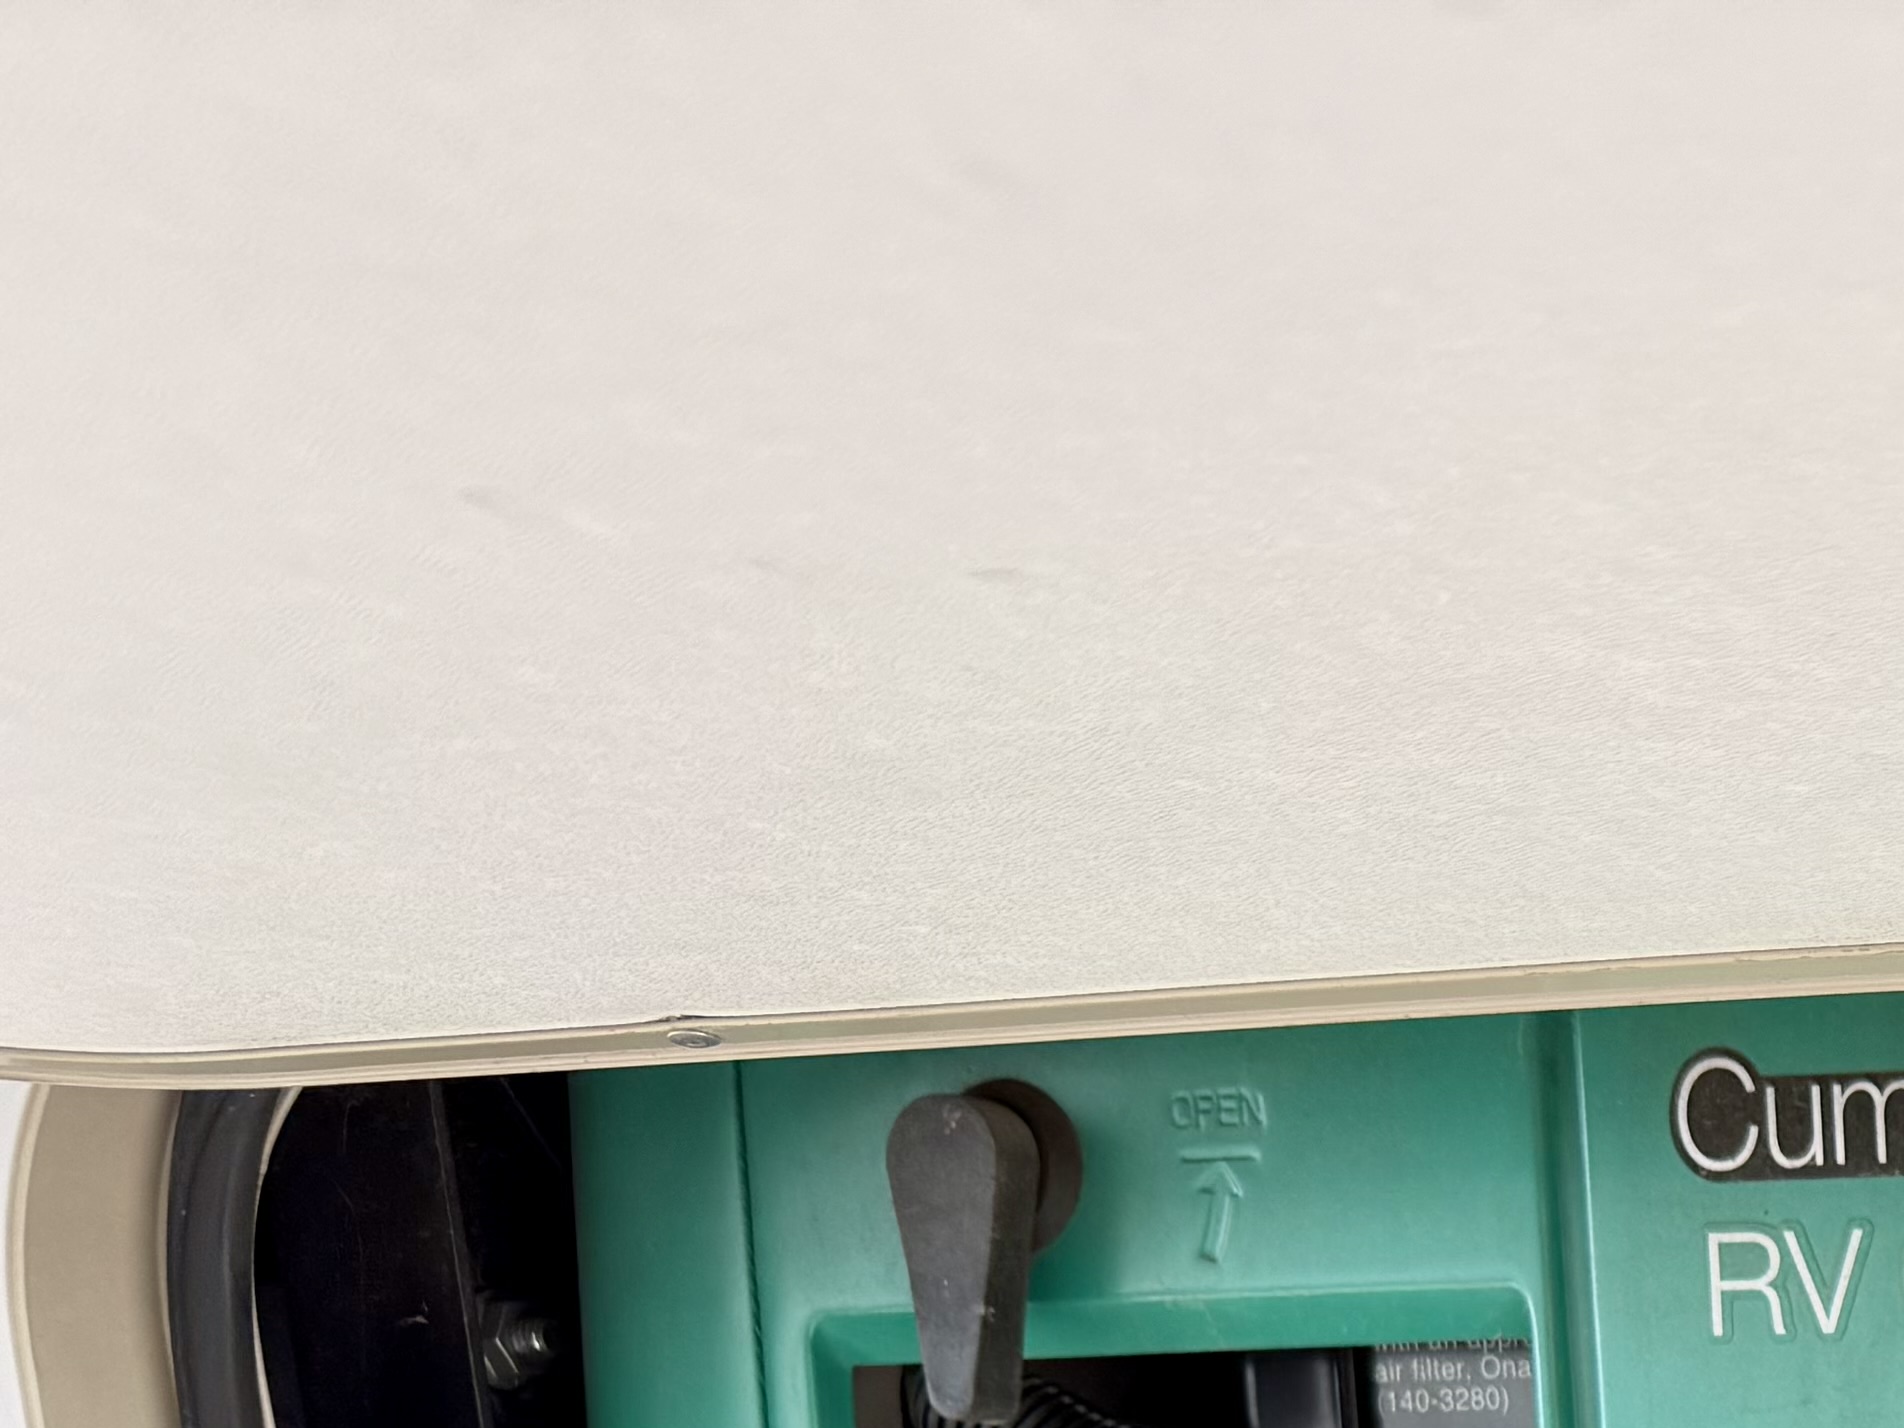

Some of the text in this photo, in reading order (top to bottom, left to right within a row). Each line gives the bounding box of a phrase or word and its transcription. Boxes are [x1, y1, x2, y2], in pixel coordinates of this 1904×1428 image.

[1171, 1086, 1268, 1129] OPEN
[1705, 1226, 1864, 1338] RV
[1375, 1360, 1401, 1382] air
[1412, 1357, 1471, 1384] filter,
[1378, 1386, 1509, 1416] (140-3280)
